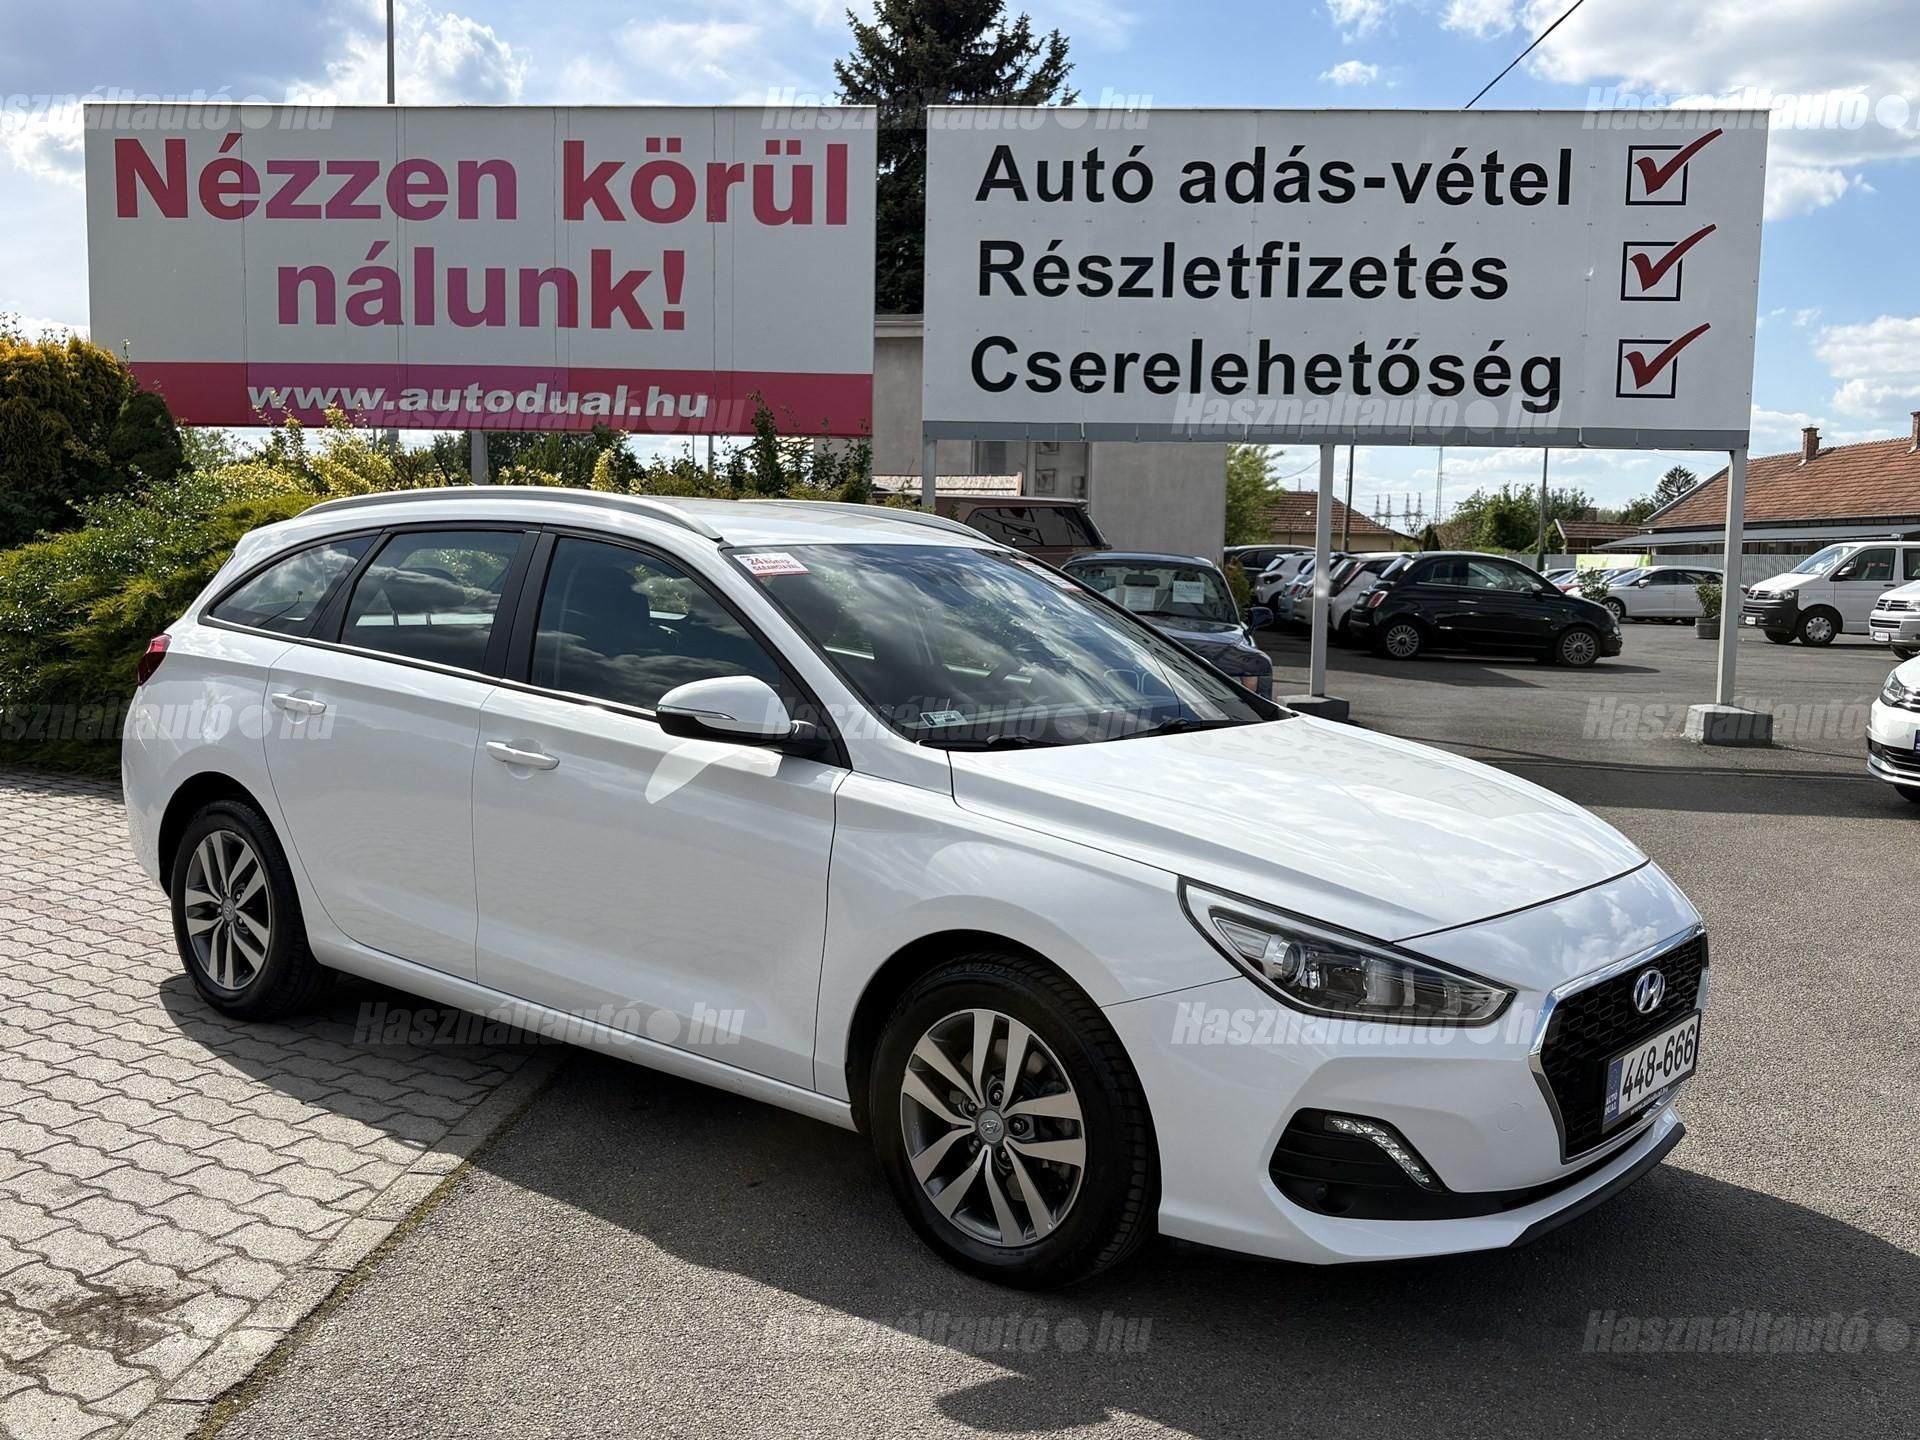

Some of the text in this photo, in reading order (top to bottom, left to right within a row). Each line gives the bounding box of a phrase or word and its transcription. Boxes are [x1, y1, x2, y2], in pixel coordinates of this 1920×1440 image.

[116, 133, 848, 225] Nézzen körül
[975, 143, 1572, 206] Autó adás-vétel
[279, 241, 685, 330] nálunk!
[979, 239, 1509, 300] Részletfizetés
[248, 382, 708, 418] www.autodual.hu
[971, 334, 1562, 413] Cserelehetőség
[1621, 1023, 1696, 1102] 448-666
